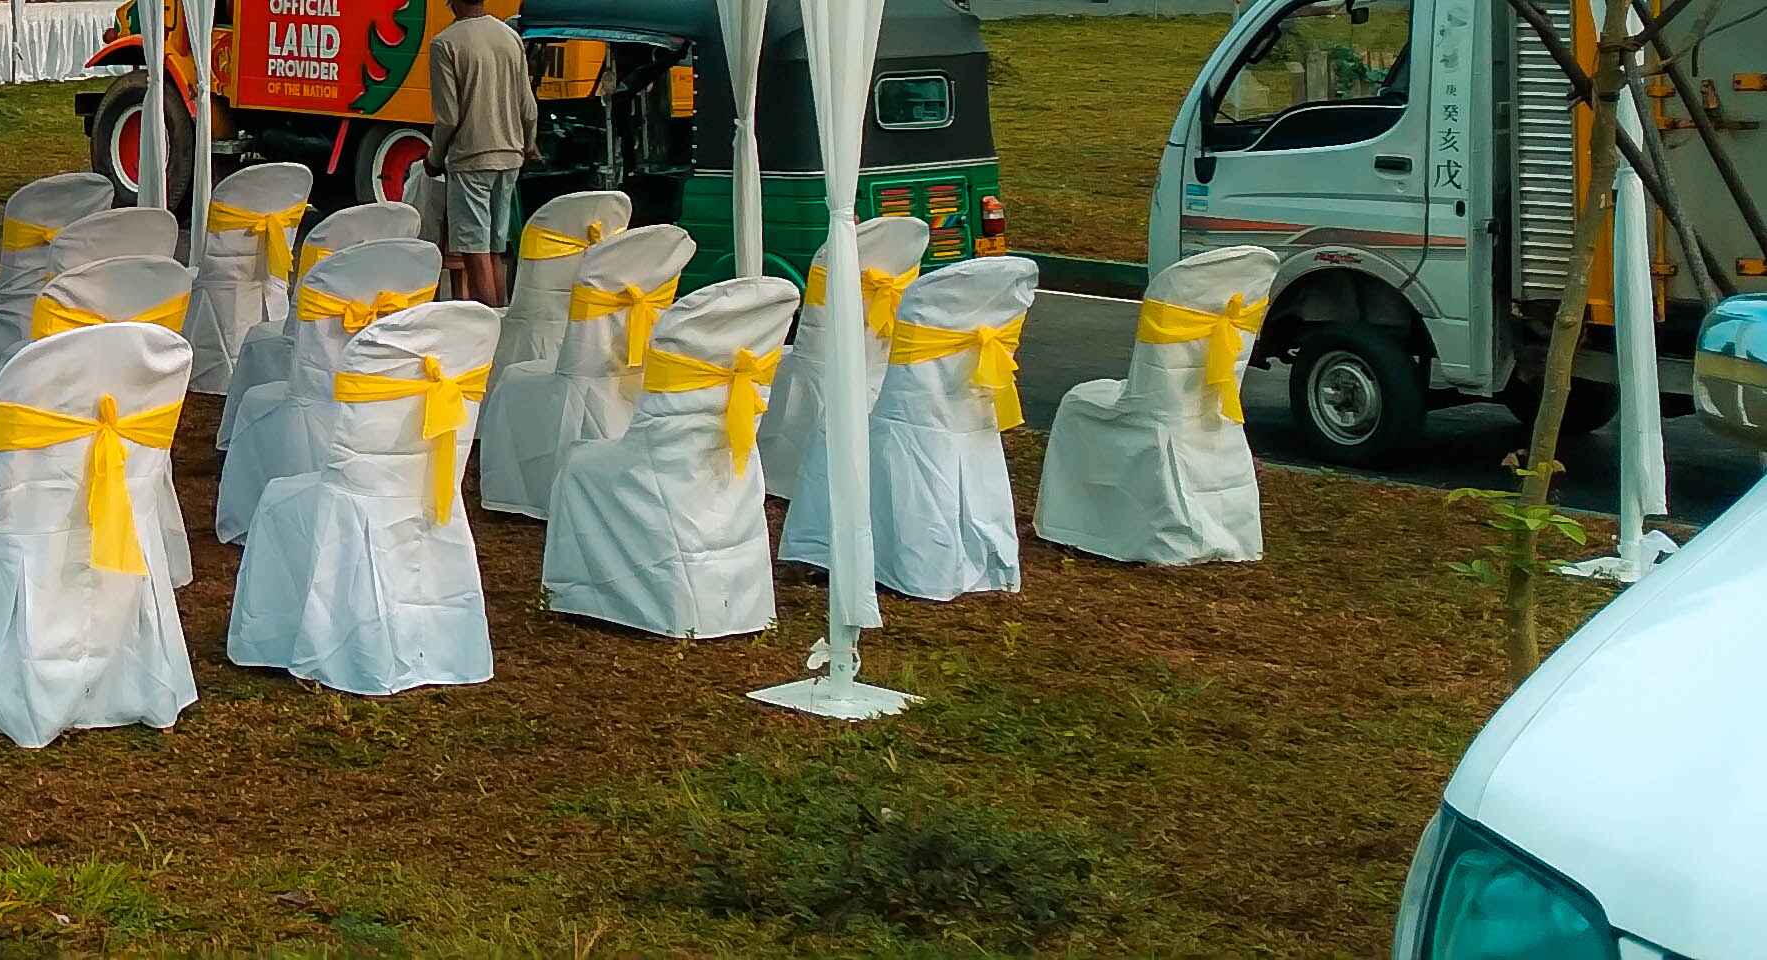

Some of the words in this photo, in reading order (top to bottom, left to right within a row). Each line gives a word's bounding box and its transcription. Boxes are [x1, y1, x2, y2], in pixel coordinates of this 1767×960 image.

[268, 21, 341, 59] LAND
[267, 58, 339, 81] PROVIDER
[267, 82, 282, 94] OF
[284, 82, 301, 97] THE
[303, 84, 338, 99] NATION
